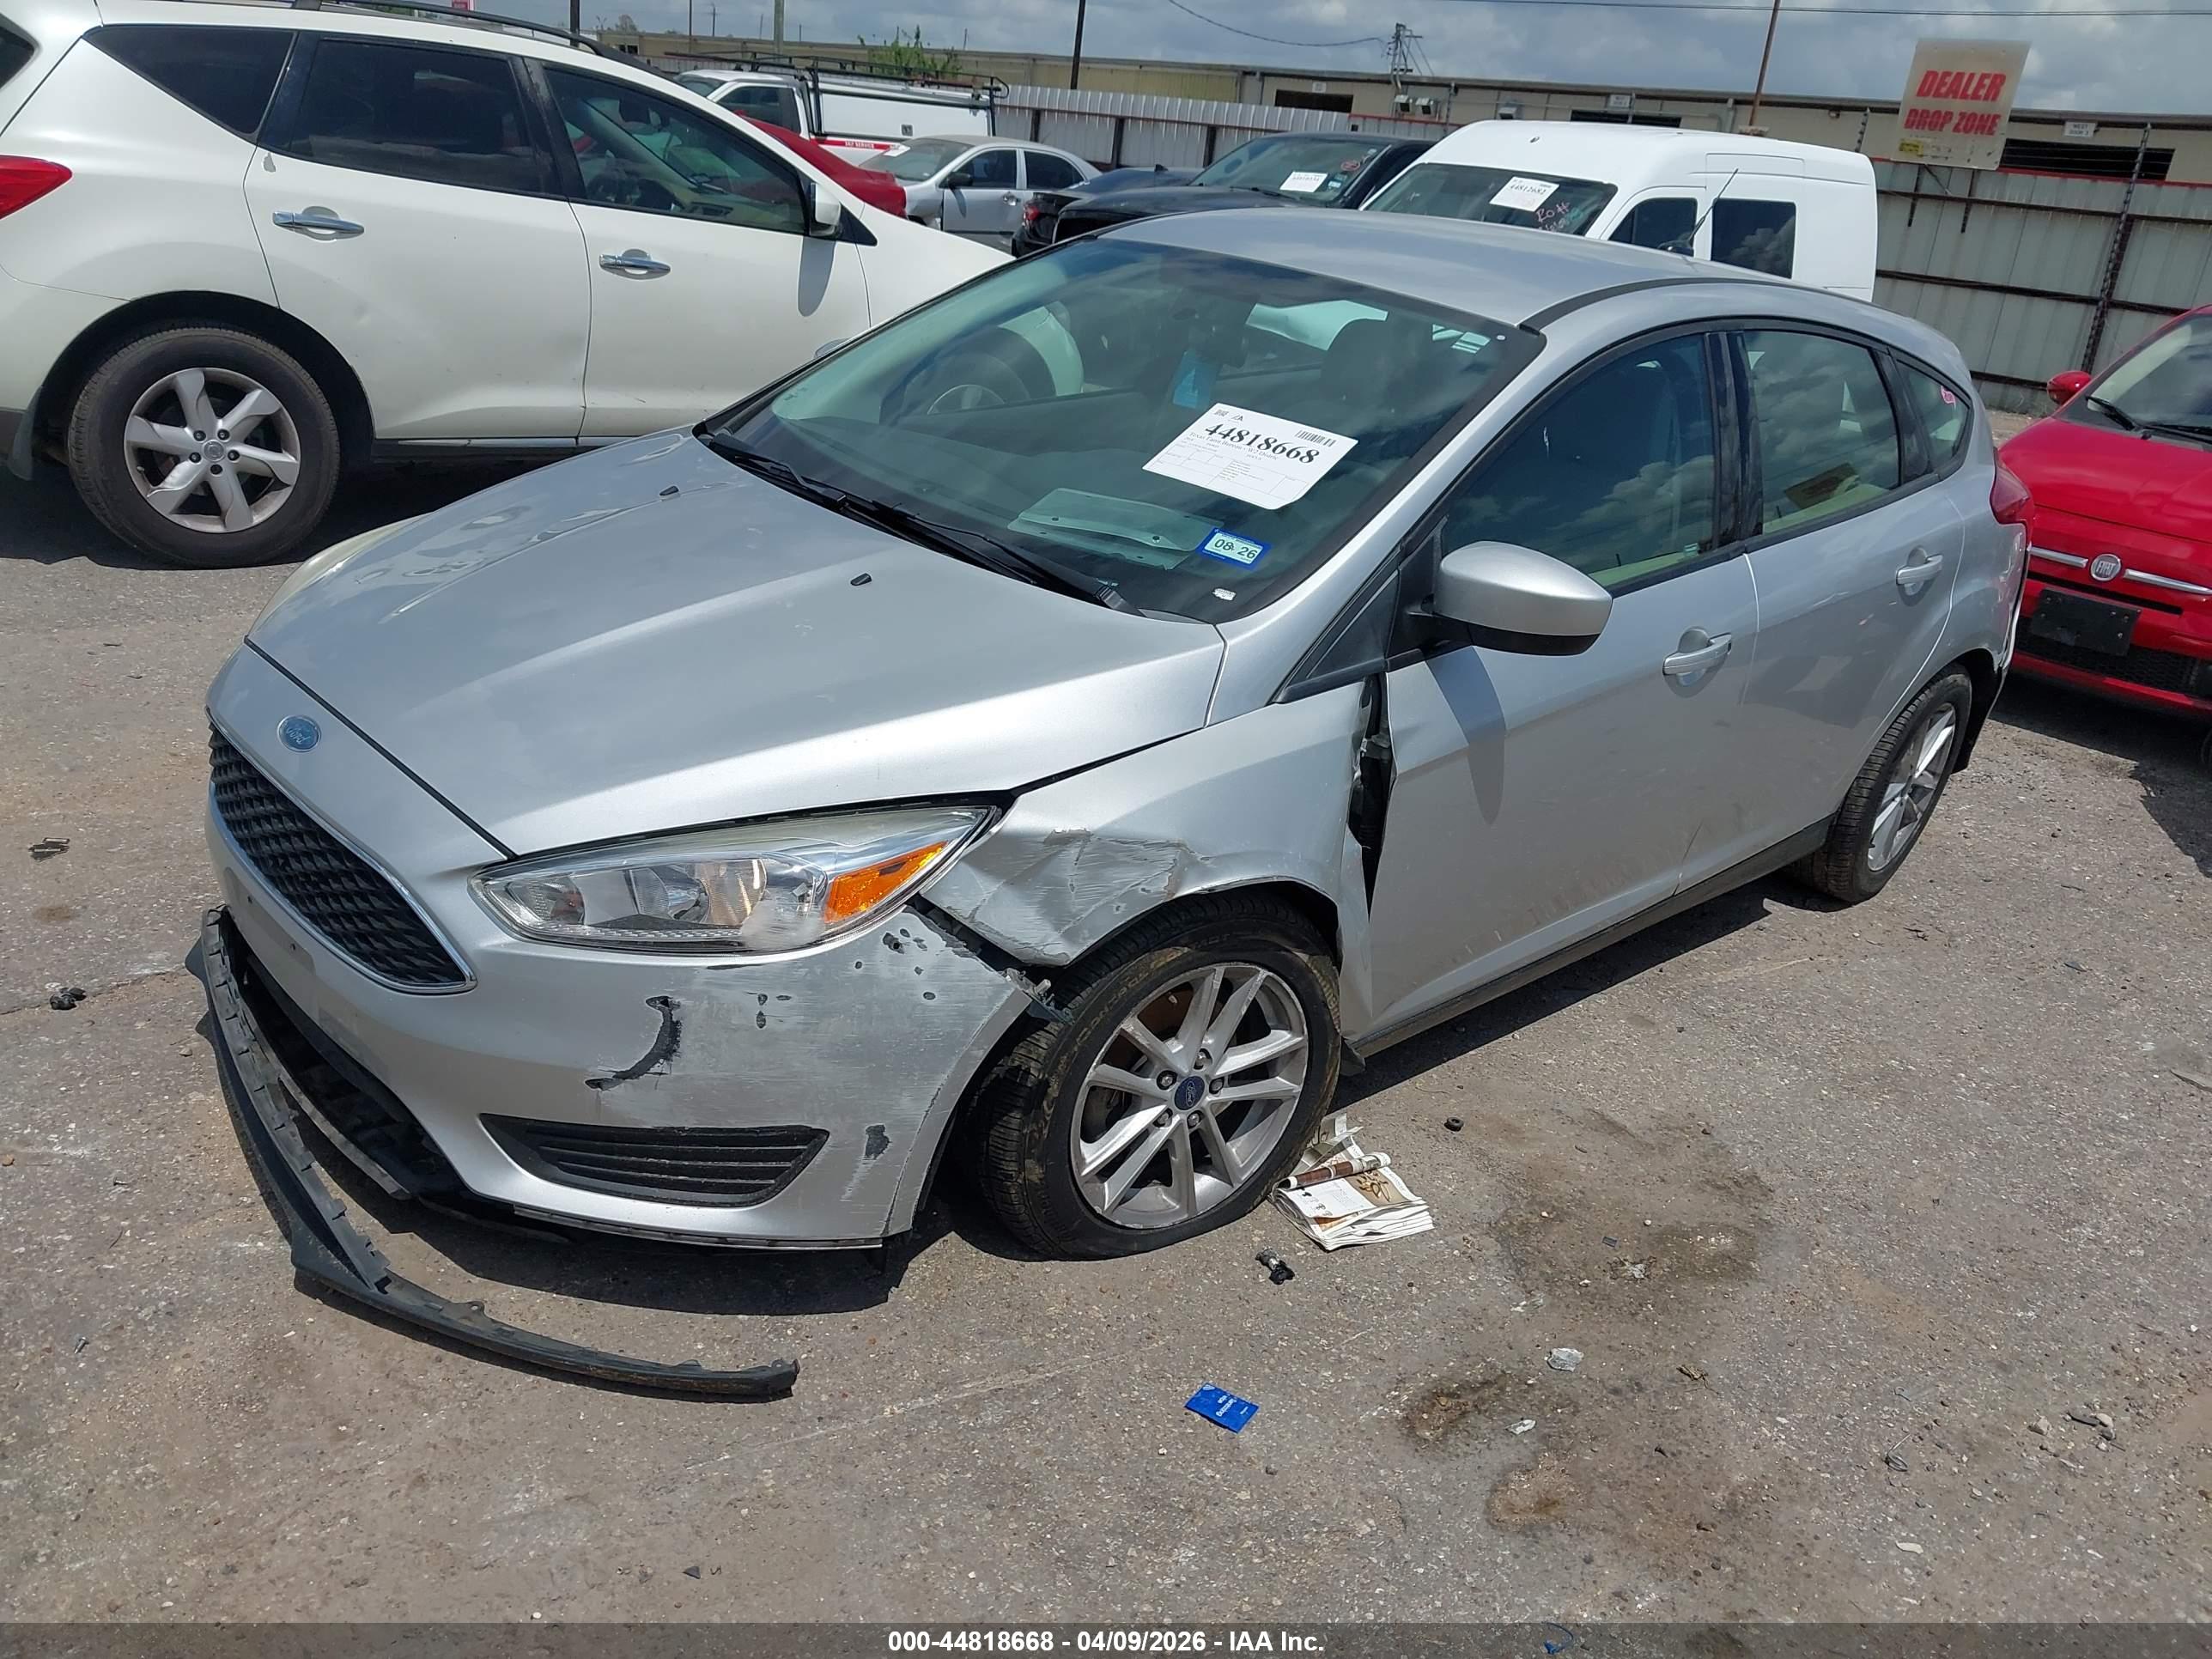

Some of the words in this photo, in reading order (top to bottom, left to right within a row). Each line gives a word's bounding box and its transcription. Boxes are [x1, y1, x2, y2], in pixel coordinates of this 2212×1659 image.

[1916, 70, 2007, 102] DEALER
[1904, 108, 1954, 131] DROP
[1952, 112, 2002, 136] ZONE
[1205, 423, 1320, 464] 44818668
[1214, 539, 1235, 550] 08
[1237, 546, 1258, 559] 26
[2095, 561, 2117, 576] FIAT
